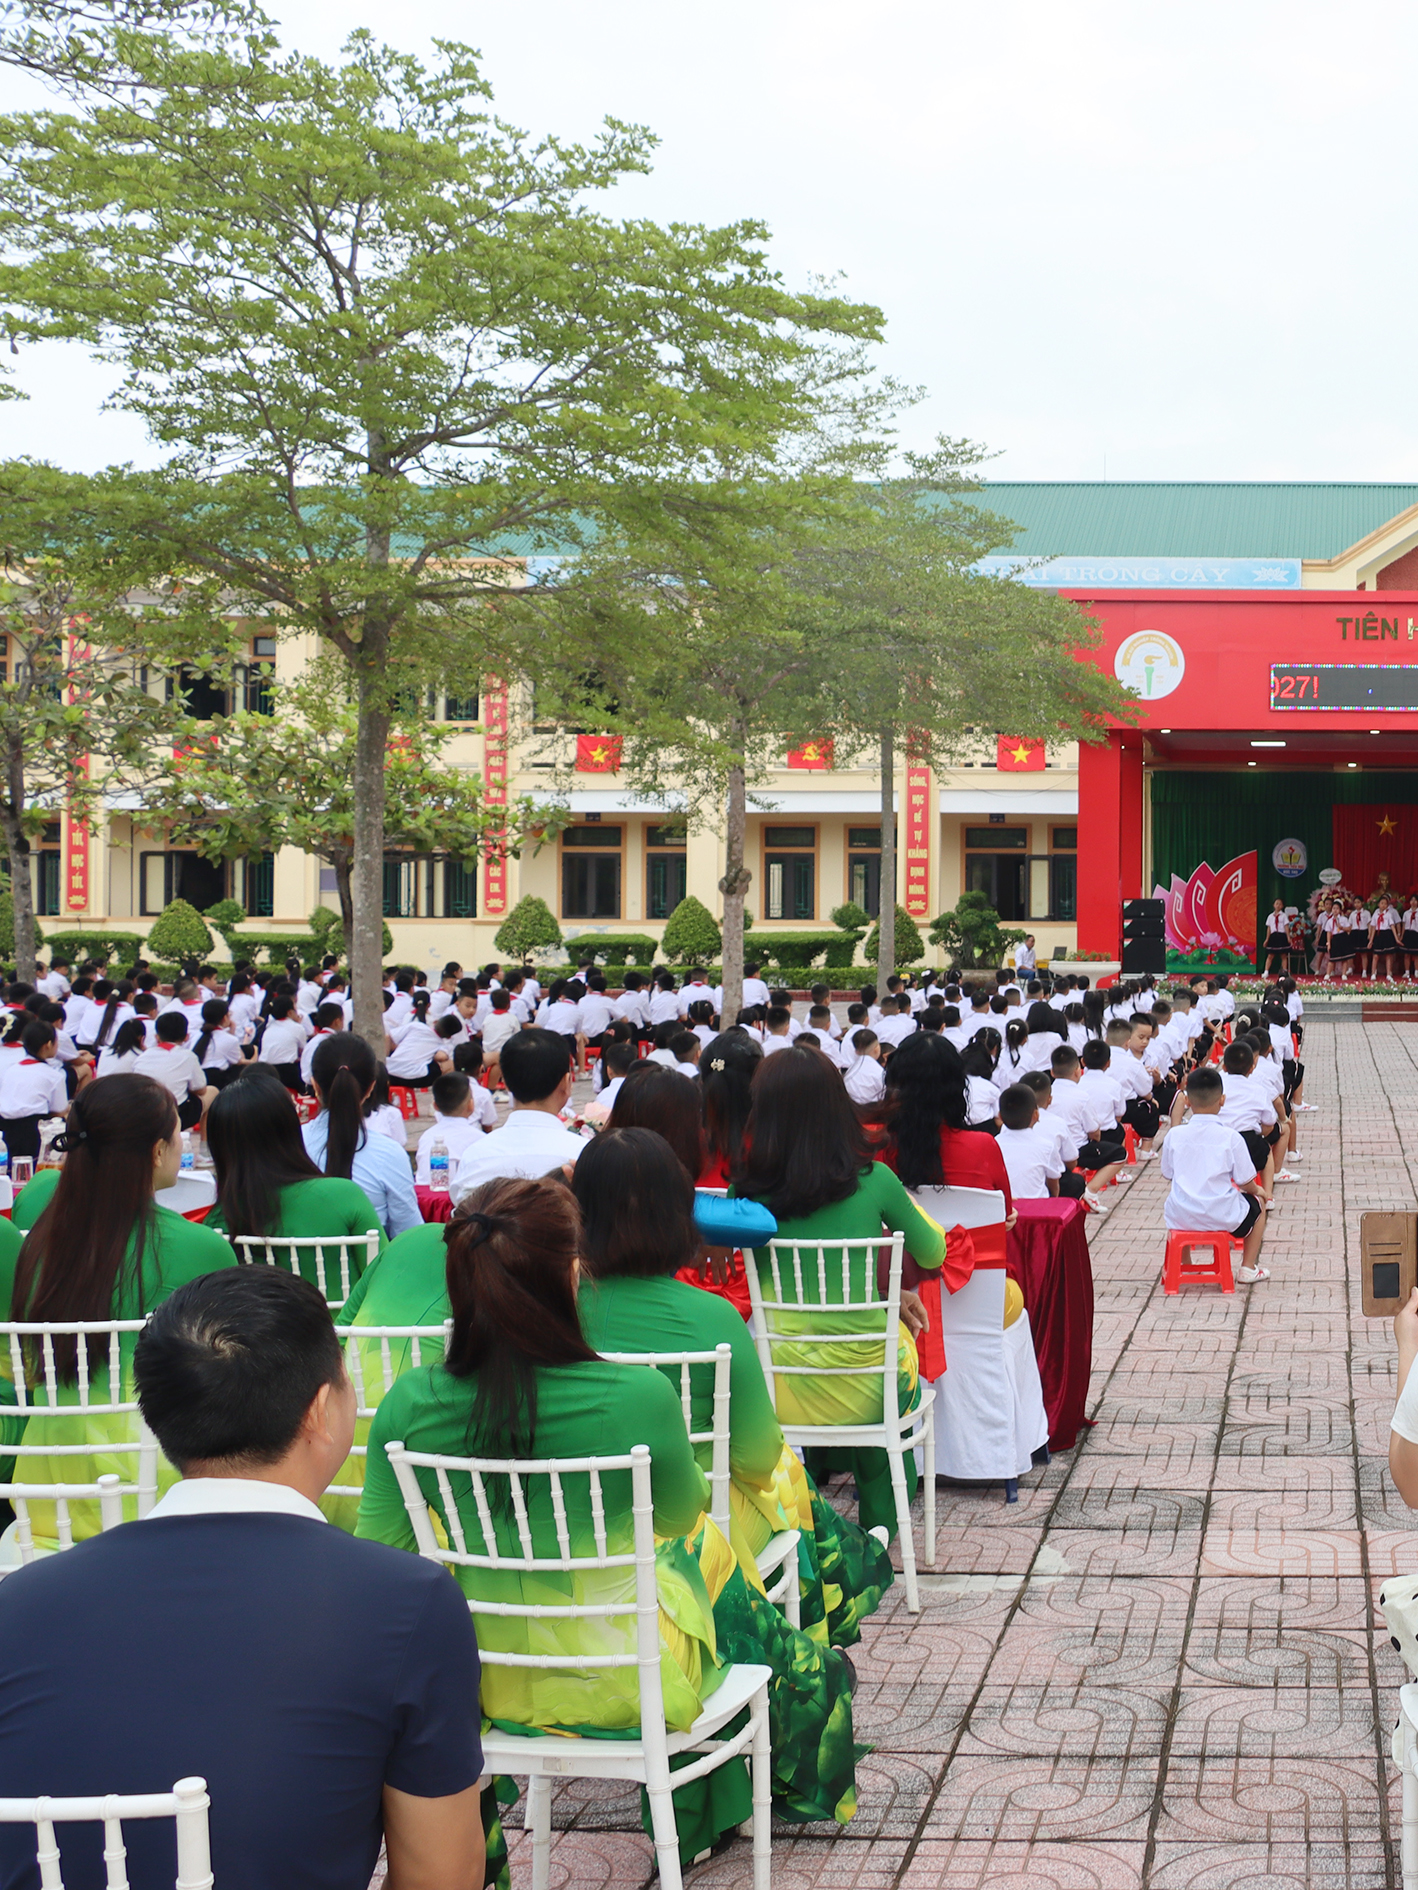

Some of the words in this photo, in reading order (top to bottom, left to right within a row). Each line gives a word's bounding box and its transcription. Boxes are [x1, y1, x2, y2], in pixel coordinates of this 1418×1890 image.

[1059, 561, 1162, 582] TRỒNG
[1170, 563, 1231, 582] CÂY
[1336, 611, 1399, 640] TIÊN
